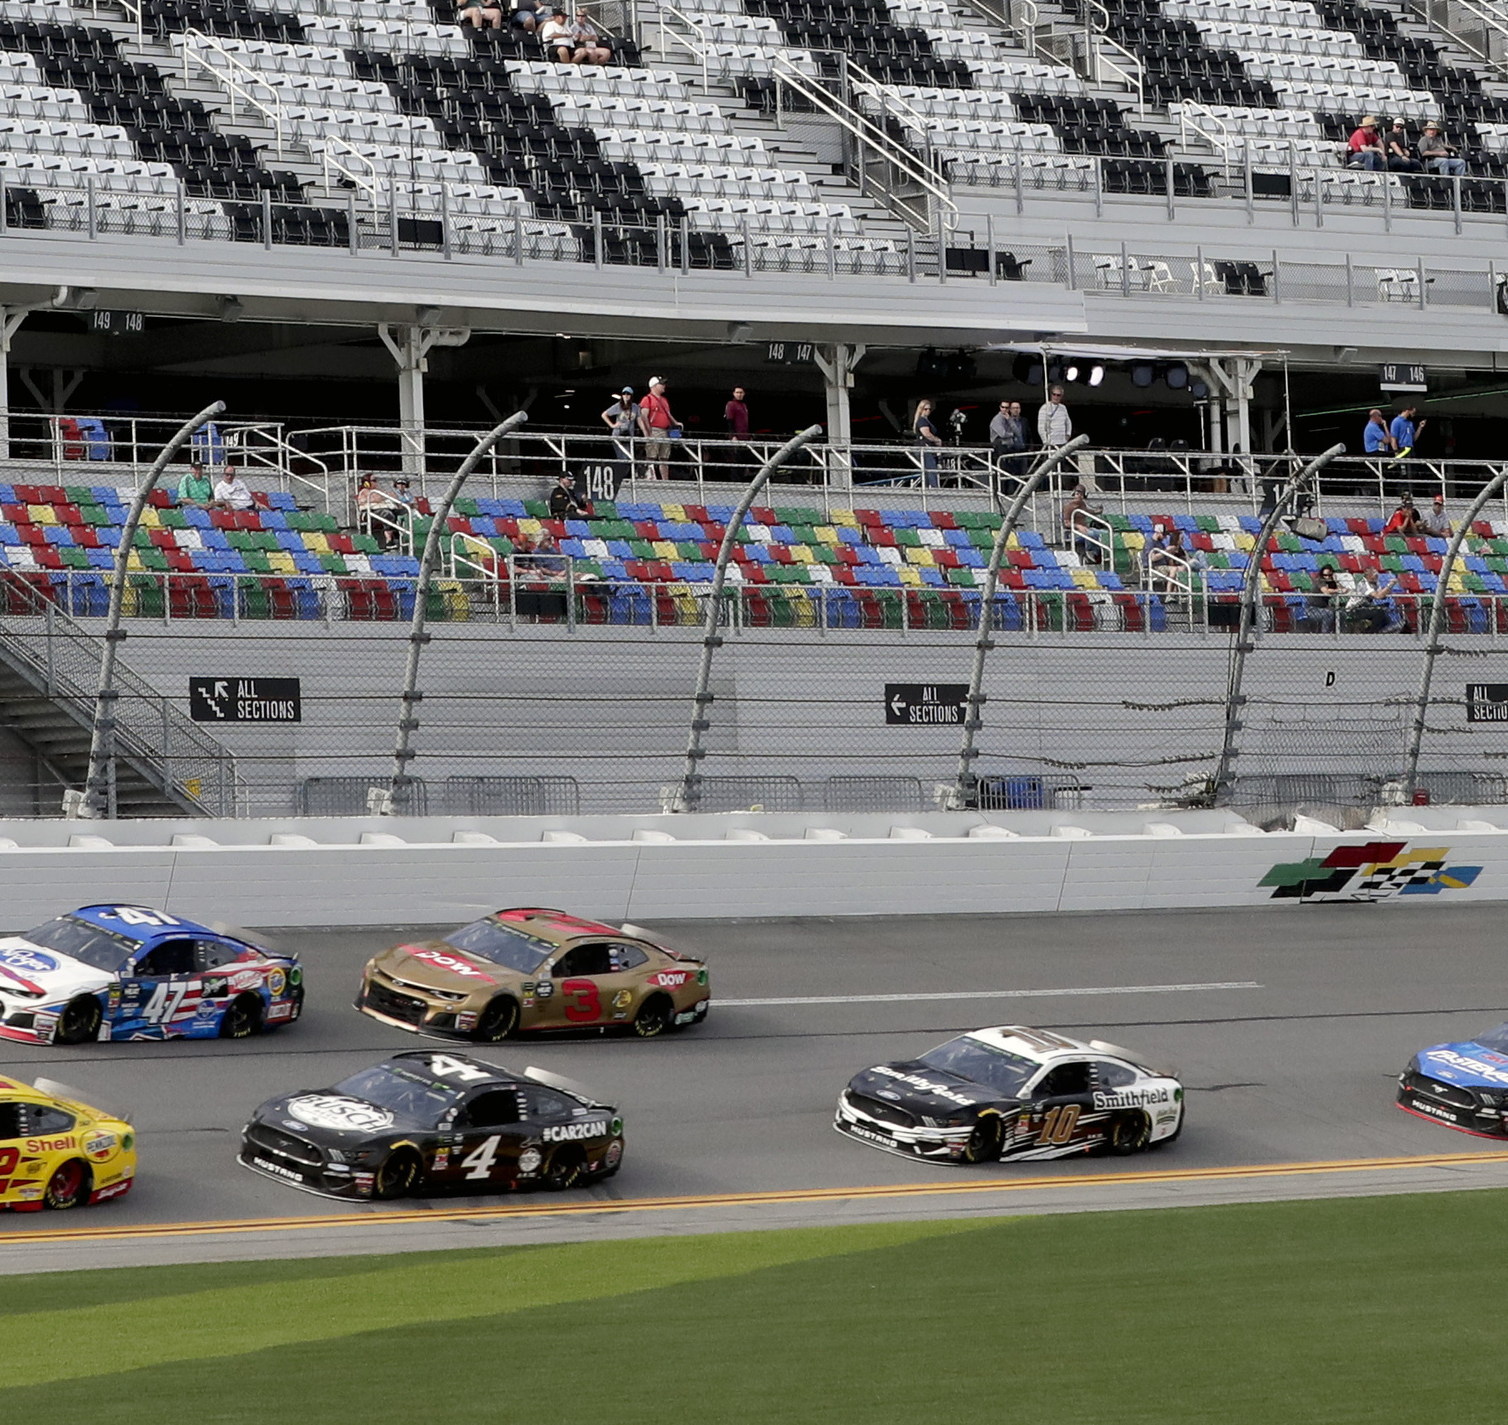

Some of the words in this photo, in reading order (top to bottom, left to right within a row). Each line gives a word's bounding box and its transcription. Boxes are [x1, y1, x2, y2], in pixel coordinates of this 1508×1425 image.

[93, 311, 111, 329] 149
[125, 313, 142, 331] 148
[768, 343, 785, 360] 148
[797, 344, 812, 361] 147
[1383, 365, 1396, 381] 147
[1409, 366, 1425, 382] 146
[583, 466, 614, 500] 148
[237, 679, 258, 699] ALL
[1325, 671, 1336, 687] D
[1473, 685, 1489, 702] ALL
[237, 701, 295, 719] SECTIONS
[909, 706, 959, 723] SECTIONS
[114, 907, 181, 926] 47
[143, 981, 189, 1025] 47
[562, 978, 603, 1023] 3
[431, 1055, 492, 1081] 4
[870, 1066, 977, 1106] Smithfield
[1094, 1088, 1169, 1109] Smithfield
[291, 1094, 389, 1136] BUSCH
[1412, 1100, 1458, 1122] MUSTANG
[543, 1121, 607, 1143] #CAR2CAN
[1034, 1104, 1081, 1145] 10
[26, 1136, 77, 1154] Shell
[86, 1134, 116, 1155] PENNZOIL
[850, 1124, 898, 1148] MUSTANG
[461, 1134, 502, 1180] 4
[253, 1156, 304, 1183] MUSTANG
